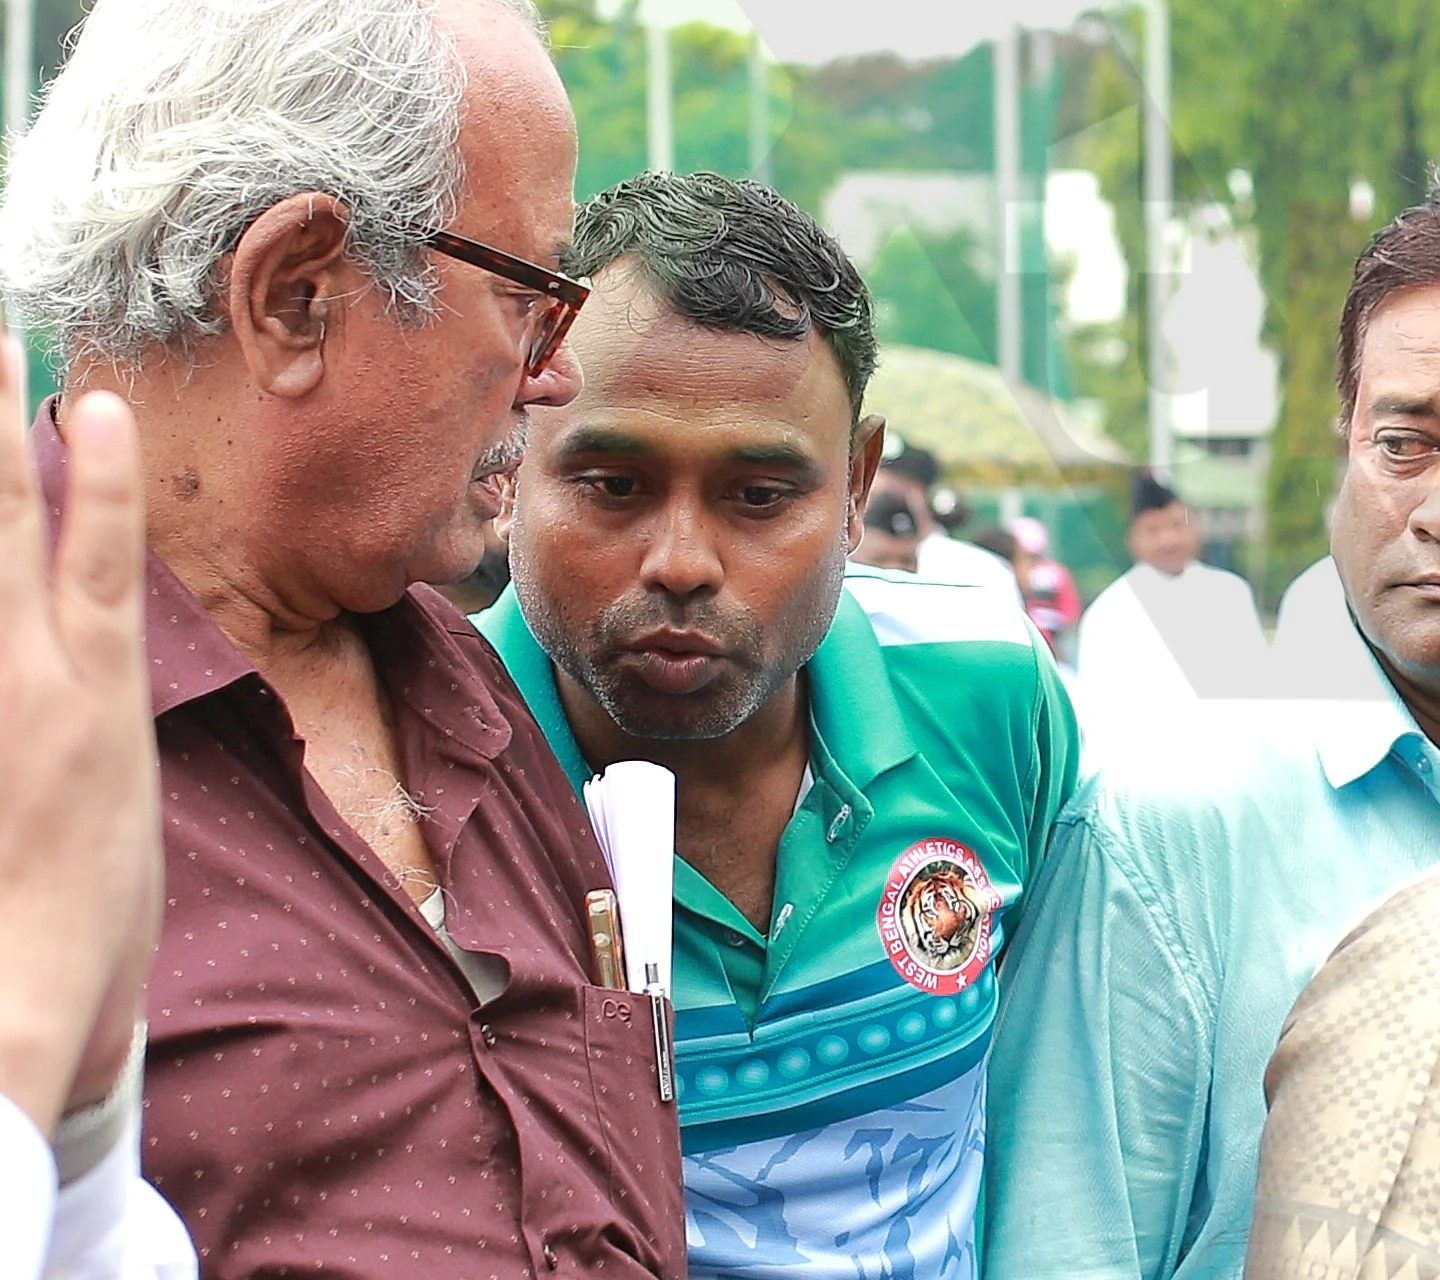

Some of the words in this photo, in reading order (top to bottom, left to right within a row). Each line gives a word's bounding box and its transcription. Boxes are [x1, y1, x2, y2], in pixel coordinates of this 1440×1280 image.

[898, 841, 964, 880] ATHLETICS
[881, 880, 904, 955] BENGAL
[896, 958, 938, 989] WEST
